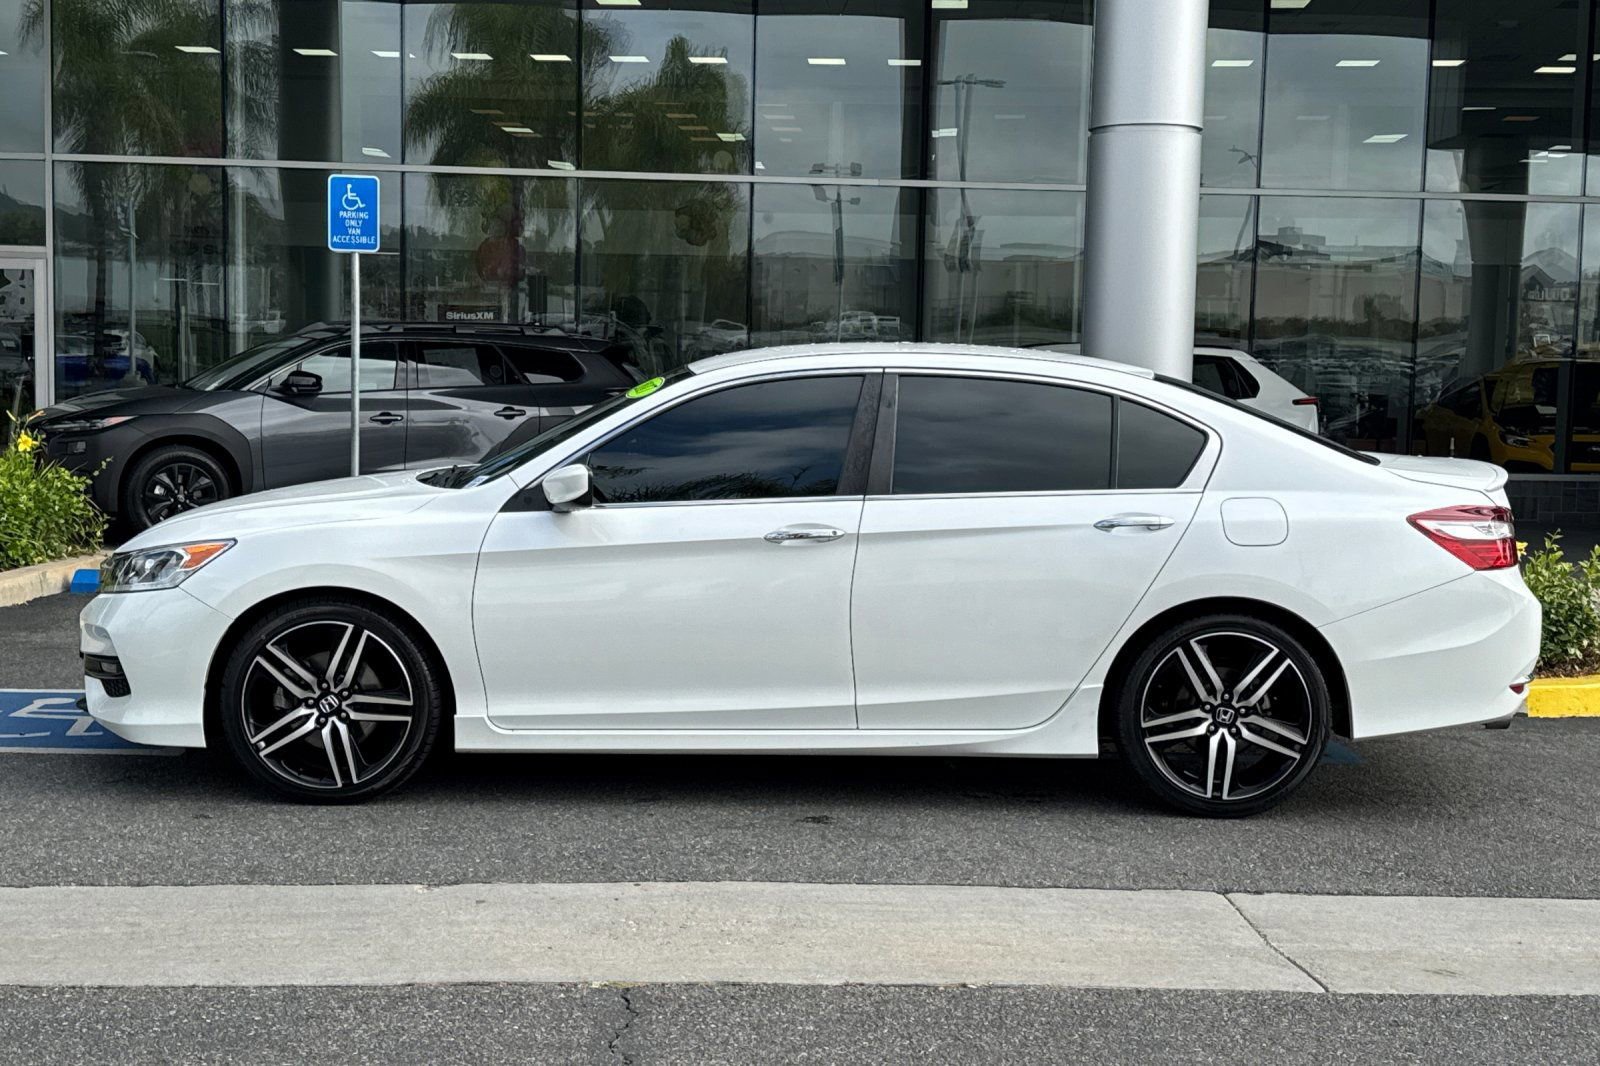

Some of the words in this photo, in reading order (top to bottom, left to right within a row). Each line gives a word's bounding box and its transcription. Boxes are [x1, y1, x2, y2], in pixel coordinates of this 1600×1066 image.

[339, 210, 368, 219] PARKING
[345, 219, 363, 227] ONLY
[347, 227, 361, 235] VAN
[332, 235, 376, 244] ACCESSIBLE
[446, 311, 494, 320] SiriusXM
